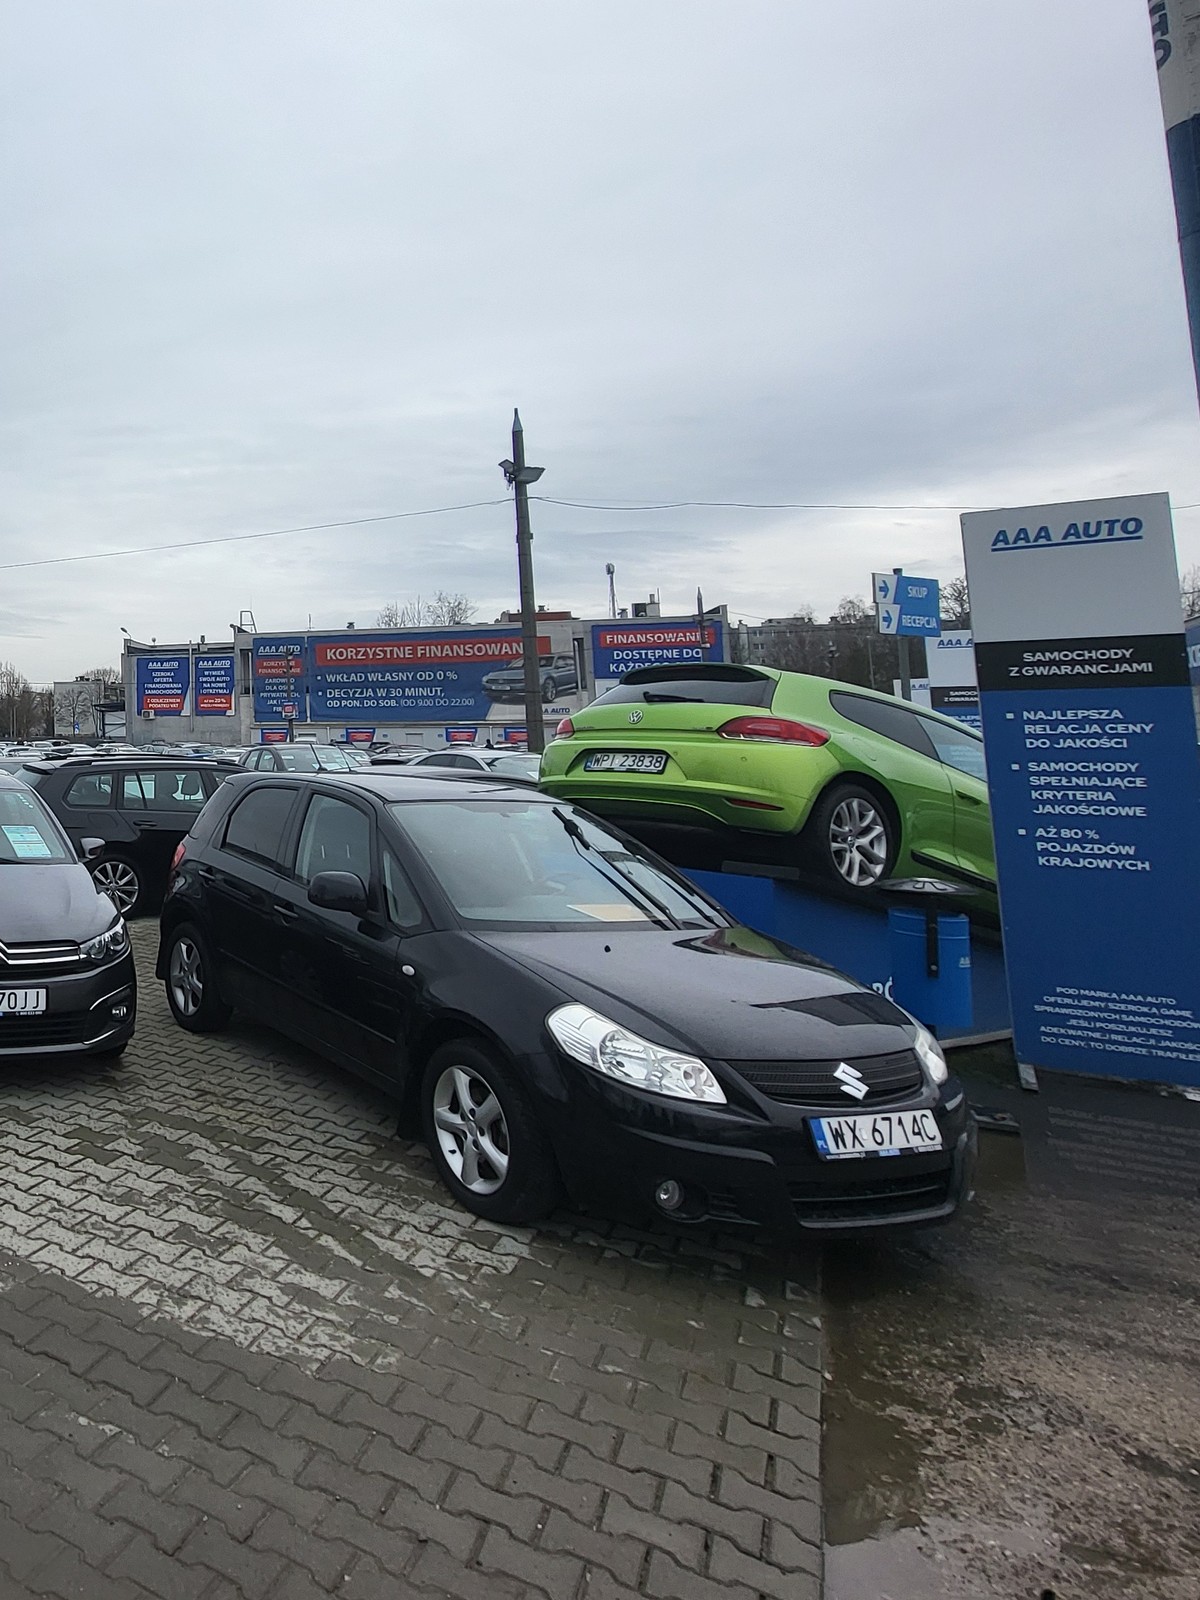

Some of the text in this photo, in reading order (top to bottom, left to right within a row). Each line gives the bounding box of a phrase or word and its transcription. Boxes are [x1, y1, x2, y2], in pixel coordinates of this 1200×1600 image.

[991, 517, 1143, 547] AAA AUTO
[907, 586, 928, 598] SKUP
[901, 614, 938, 629] RECEPCJA
[606, 632, 709, 645] FINANSOWANI
[937, 639, 962, 647] AAA
[326, 642, 524, 660] KORZYSTNE FINANSOWAN
[613, 648, 703, 661] DOSTĘPNE DO
[1022, 648, 1134, 662] SAMOCHODY
[609, 661, 670, 673] KAŻD
[1008, 662, 1154, 677] Z GWARANCJAMI
[326, 671, 458, 683] WKŁAD WŁASNY OD 0 %
[326, 687, 445, 698] DECYZJA W 30 MINUT,
[326, 700, 340, 708] OD
[341, 700, 362, 708] PON.
[401, 699, 416, 707] (OD
[435, 698, 449, 706] DO
[450, 698, 475, 706] 22.00)
[1023, 709, 1124, 720] NAJLEPSZA
[1024, 723, 1154, 734] RELACJA CENY
[1025, 736, 1128, 749] DO JAKOŚCI
[592, 754, 616, 767] WPI
[619, 754, 664, 769] 23838
[1027, 762, 1139, 773] SAMOCHODY
[1029, 776, 1148, 790] SPEŁNIAJĄCE
[1031, 790, 1117, 802] KRYTERIA
[1033, 803, 1148, 817] JAKOŚCIOWE
[1035, 826, 1100, 840] AŻ 80 %
[1036, 842, 1135, 856] POJAZDÓW
[1038, 856, 1151, 871] KRAJOWYCH
[1043, 996, 1107, 1008] OFERUJEMY
[1056, 986, 1079, 995] POD
[1120, 993, 1144, 1002] AAA
[1145, 997, 1176, 1005] AUTO
[1034, 1005, 1120, 1020] SPRAWDZONYCH
[1040, 1026, 1109, 1040] ADEKWATNEJ
[1157, 1040, 1200, 1050] JAKOŚC
[1089, 1041, 1104, 1049] TO
[1105, 1043, 1150, 1055] DOBRZE
[827, 1120, 864, 1149] WX
[872, 1113, 936, 1146] 6714C
